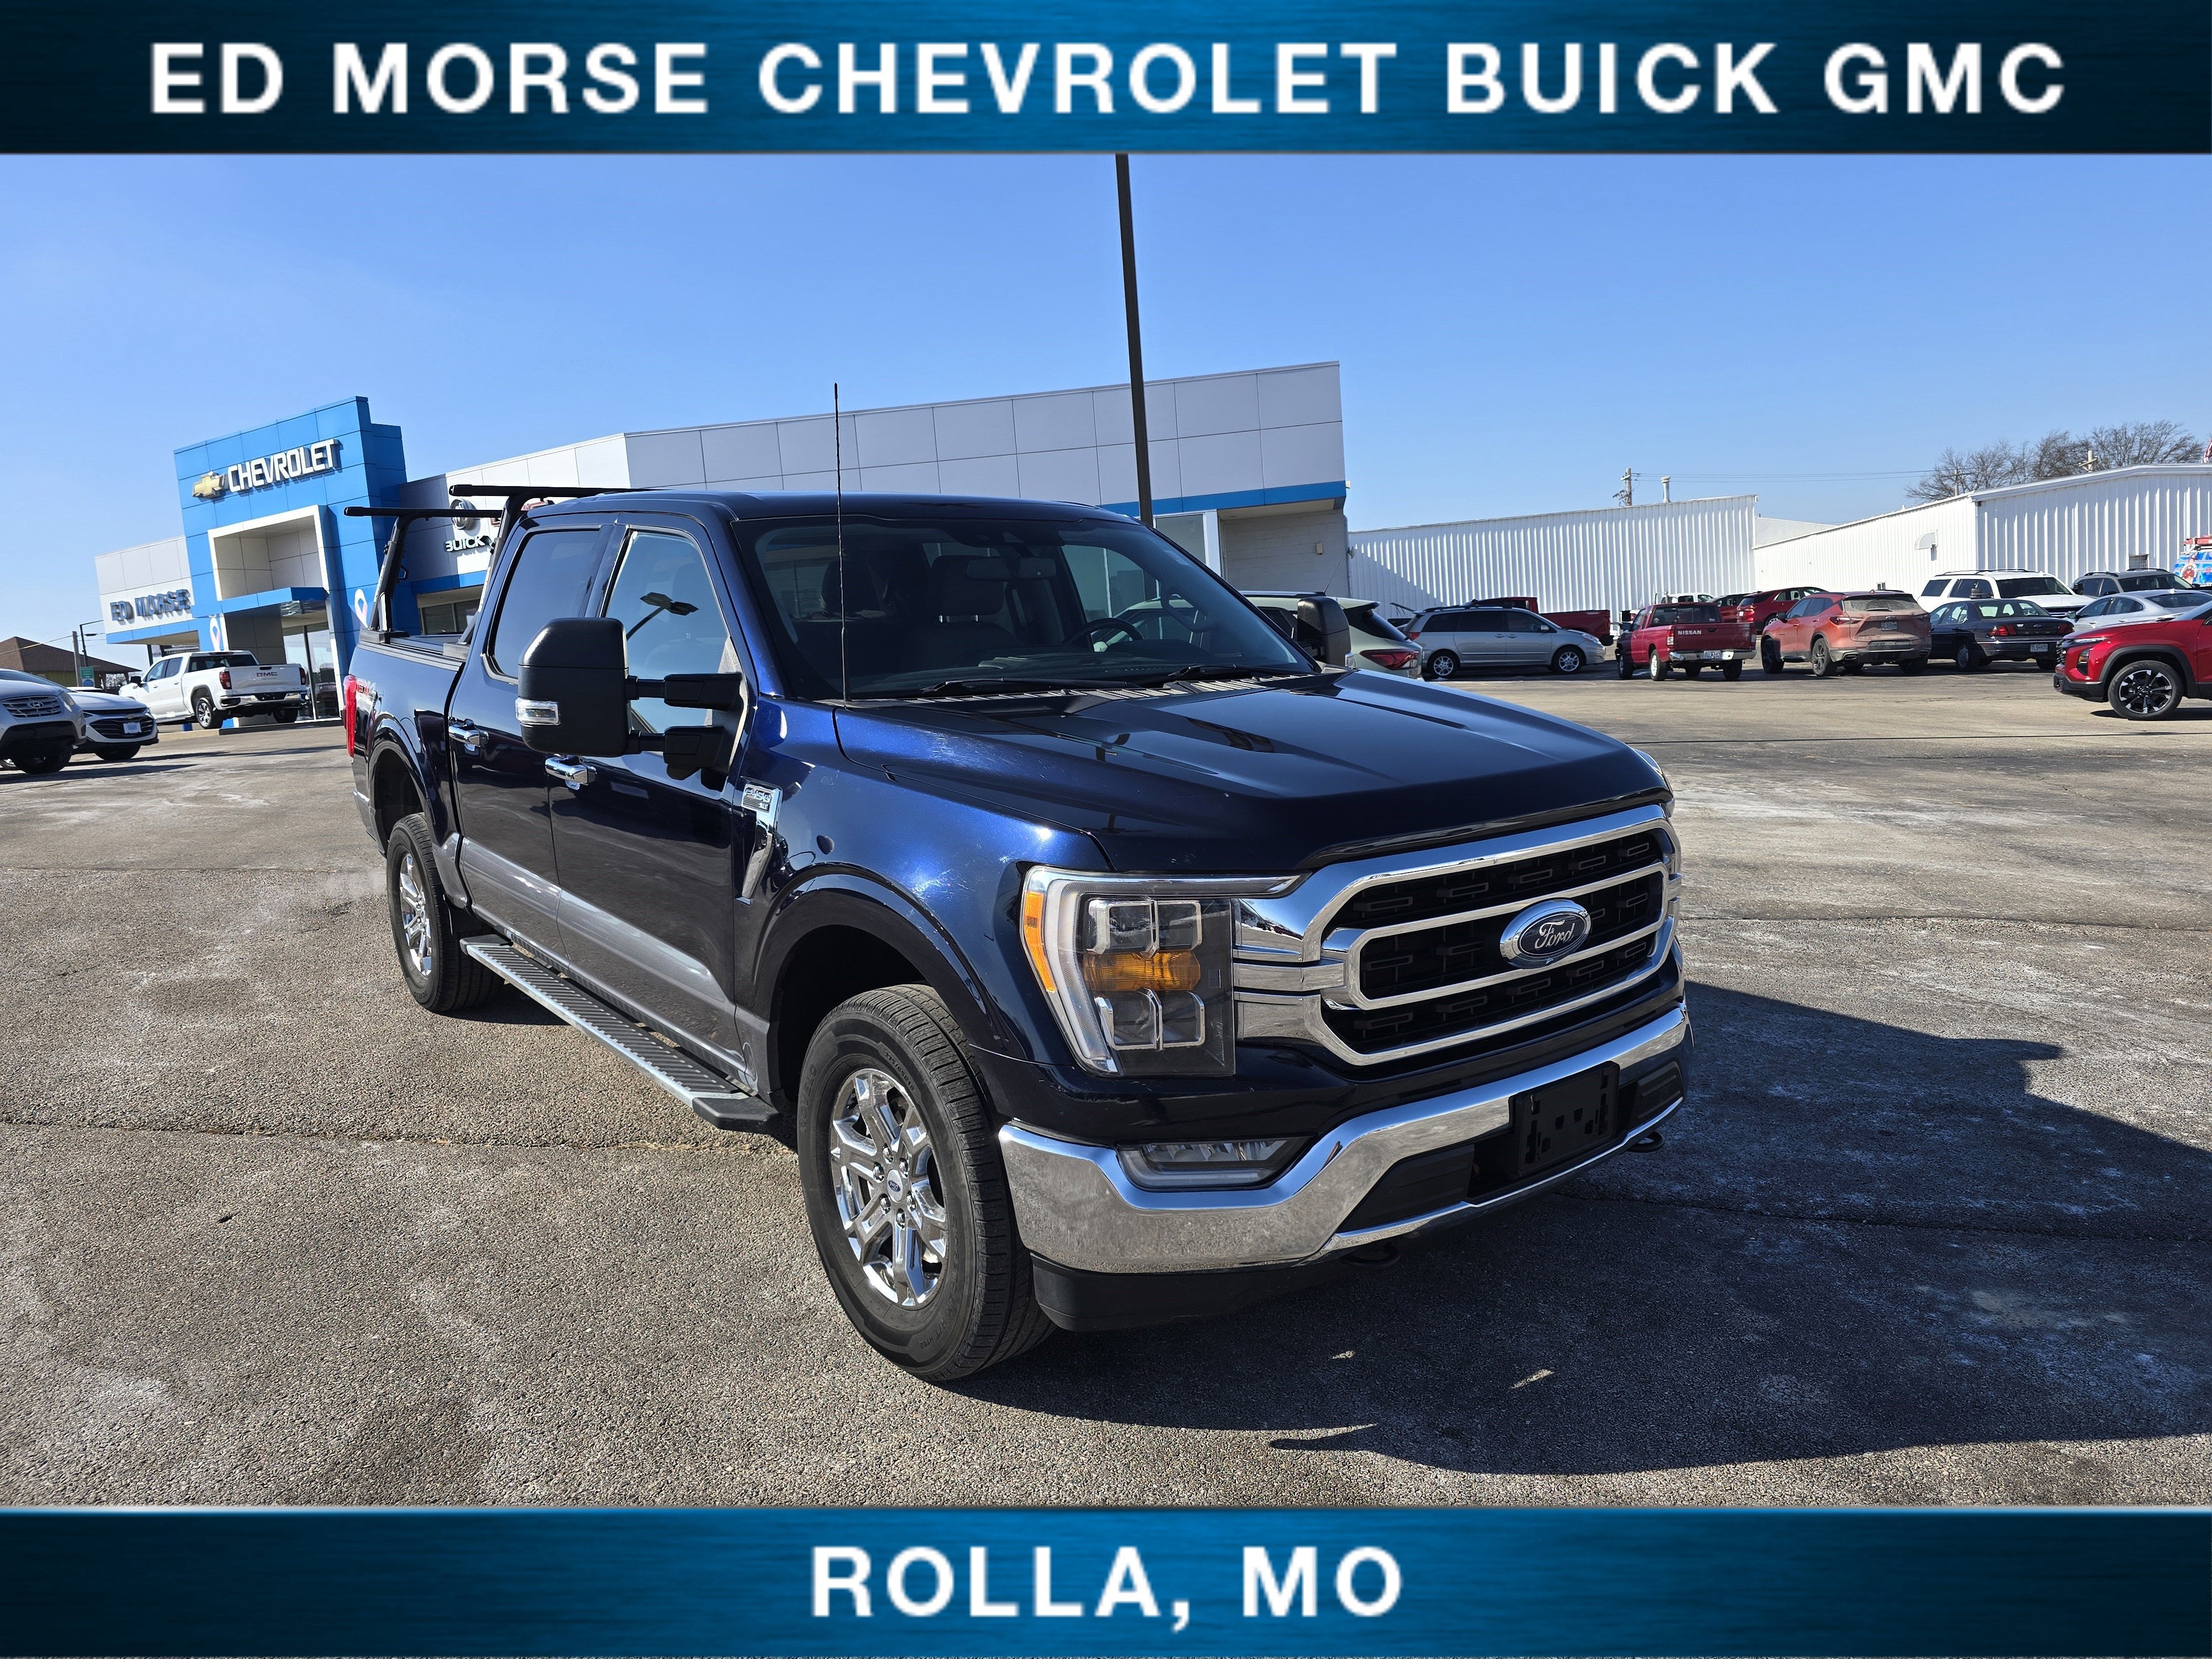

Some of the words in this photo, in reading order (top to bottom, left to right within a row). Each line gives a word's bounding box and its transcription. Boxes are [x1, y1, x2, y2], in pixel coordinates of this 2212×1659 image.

[227, 439, 335, 493] CHEVROLET
[444, 535, 486, 552] BUICK
[109, 600, 129, 621] ED
[134, 589, 189, 617] MORSE
[356, 678, 377, 695] FX4
[1534, 919, 1575, 950] Ford
